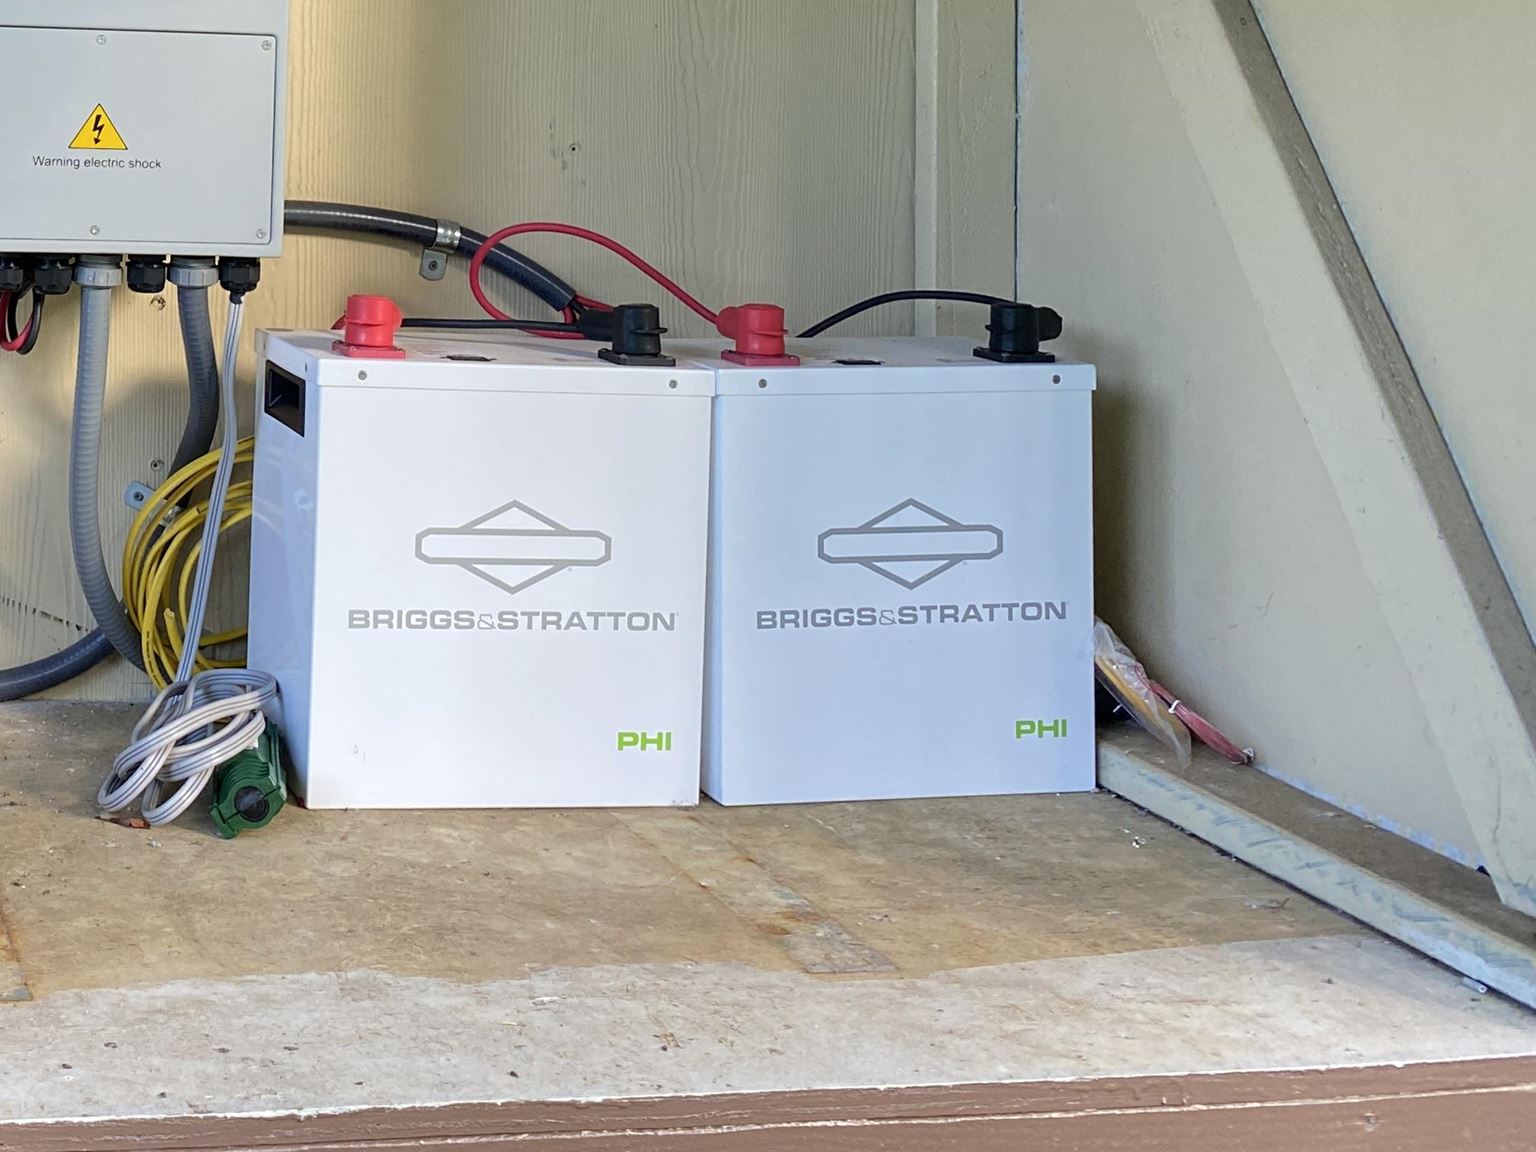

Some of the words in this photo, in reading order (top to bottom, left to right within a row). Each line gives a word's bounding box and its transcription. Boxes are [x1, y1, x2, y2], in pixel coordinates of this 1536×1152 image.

[32, 155, 80, 170] Warning
[83, 157, 125, 169] electric
[128, 158, 162, 169] shock
[347, 609, 676, 631] BRIGGS&STRATTON
[756, 601, 1068, 630] BRIGGS&STRATTON
[1015, 718, 1068, 739] PHI
[617, 731, 672, 751] PHI
